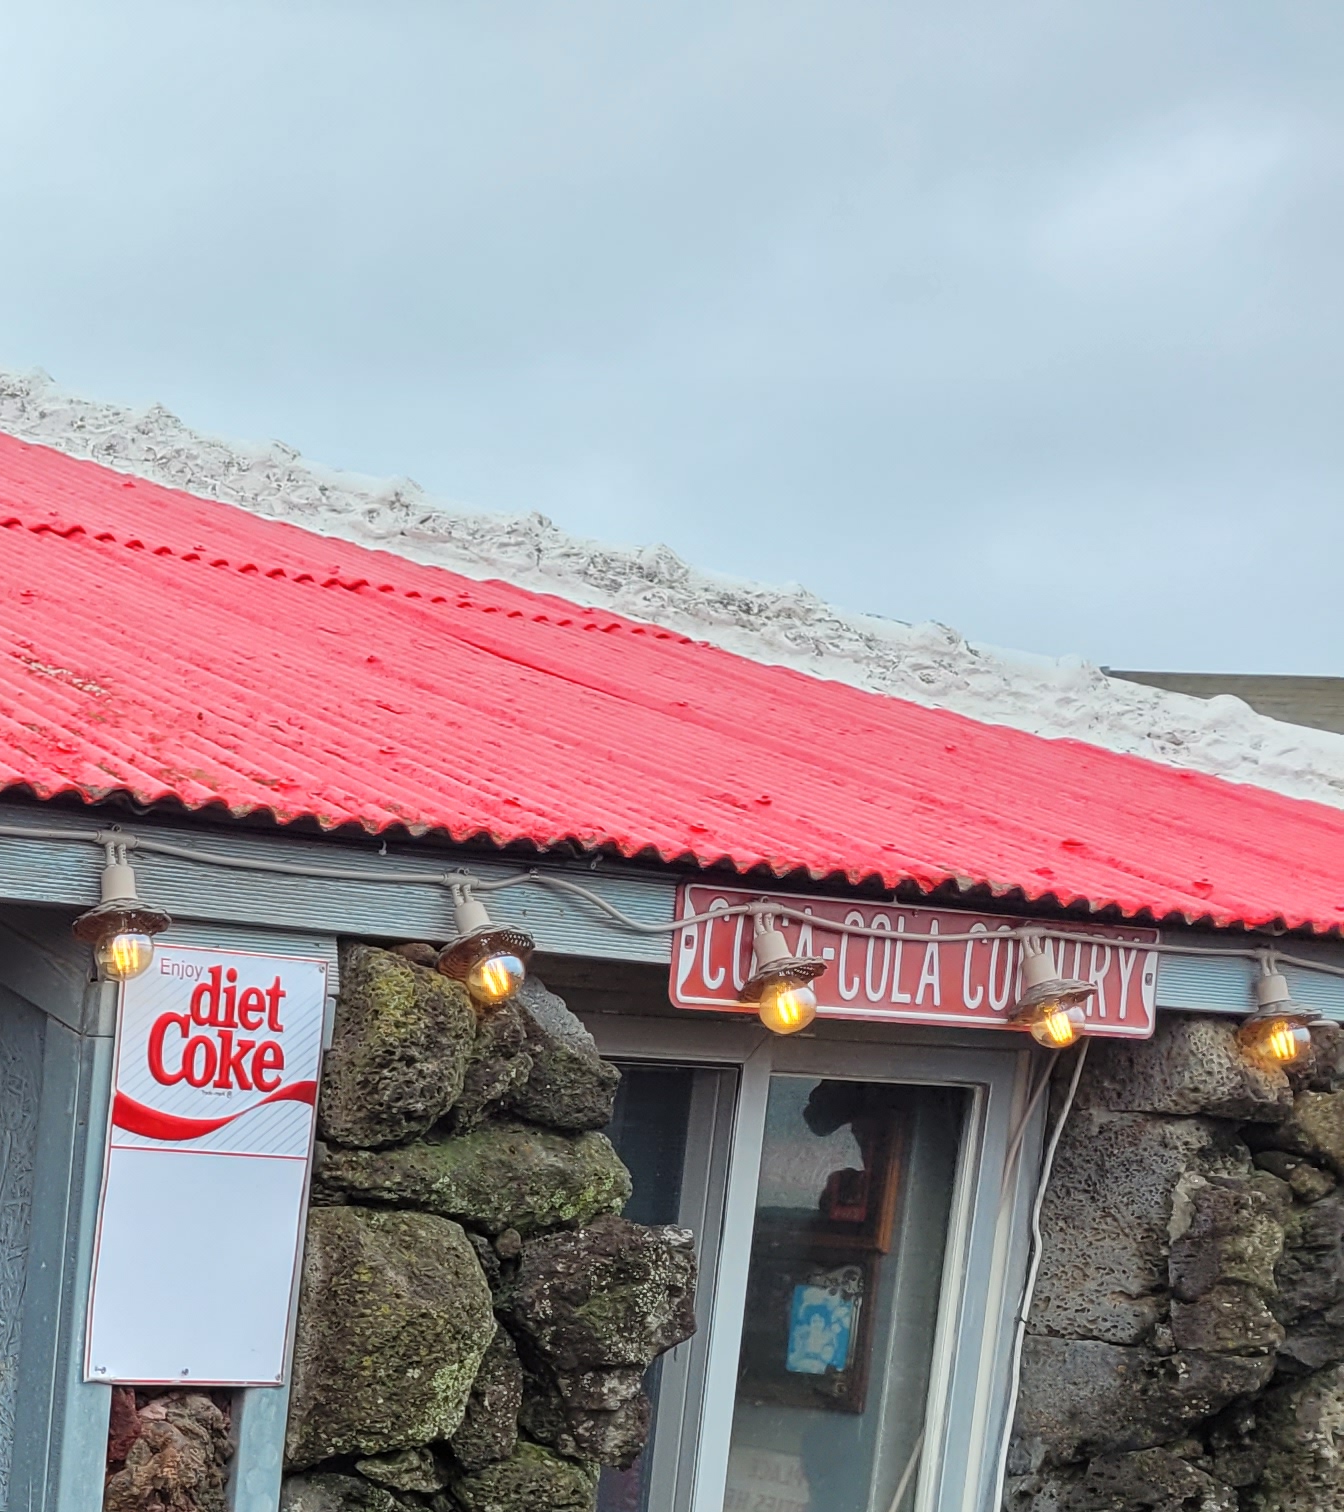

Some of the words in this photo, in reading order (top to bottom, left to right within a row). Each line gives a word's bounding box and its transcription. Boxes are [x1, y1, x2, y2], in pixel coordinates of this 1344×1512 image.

[160, 957, 203, 981] Enjoy
[703, 897, 941, 1006] COA-COLA
[190, 964, 287, 1032] diet
[148, 1011, 286, 1092] Coke
